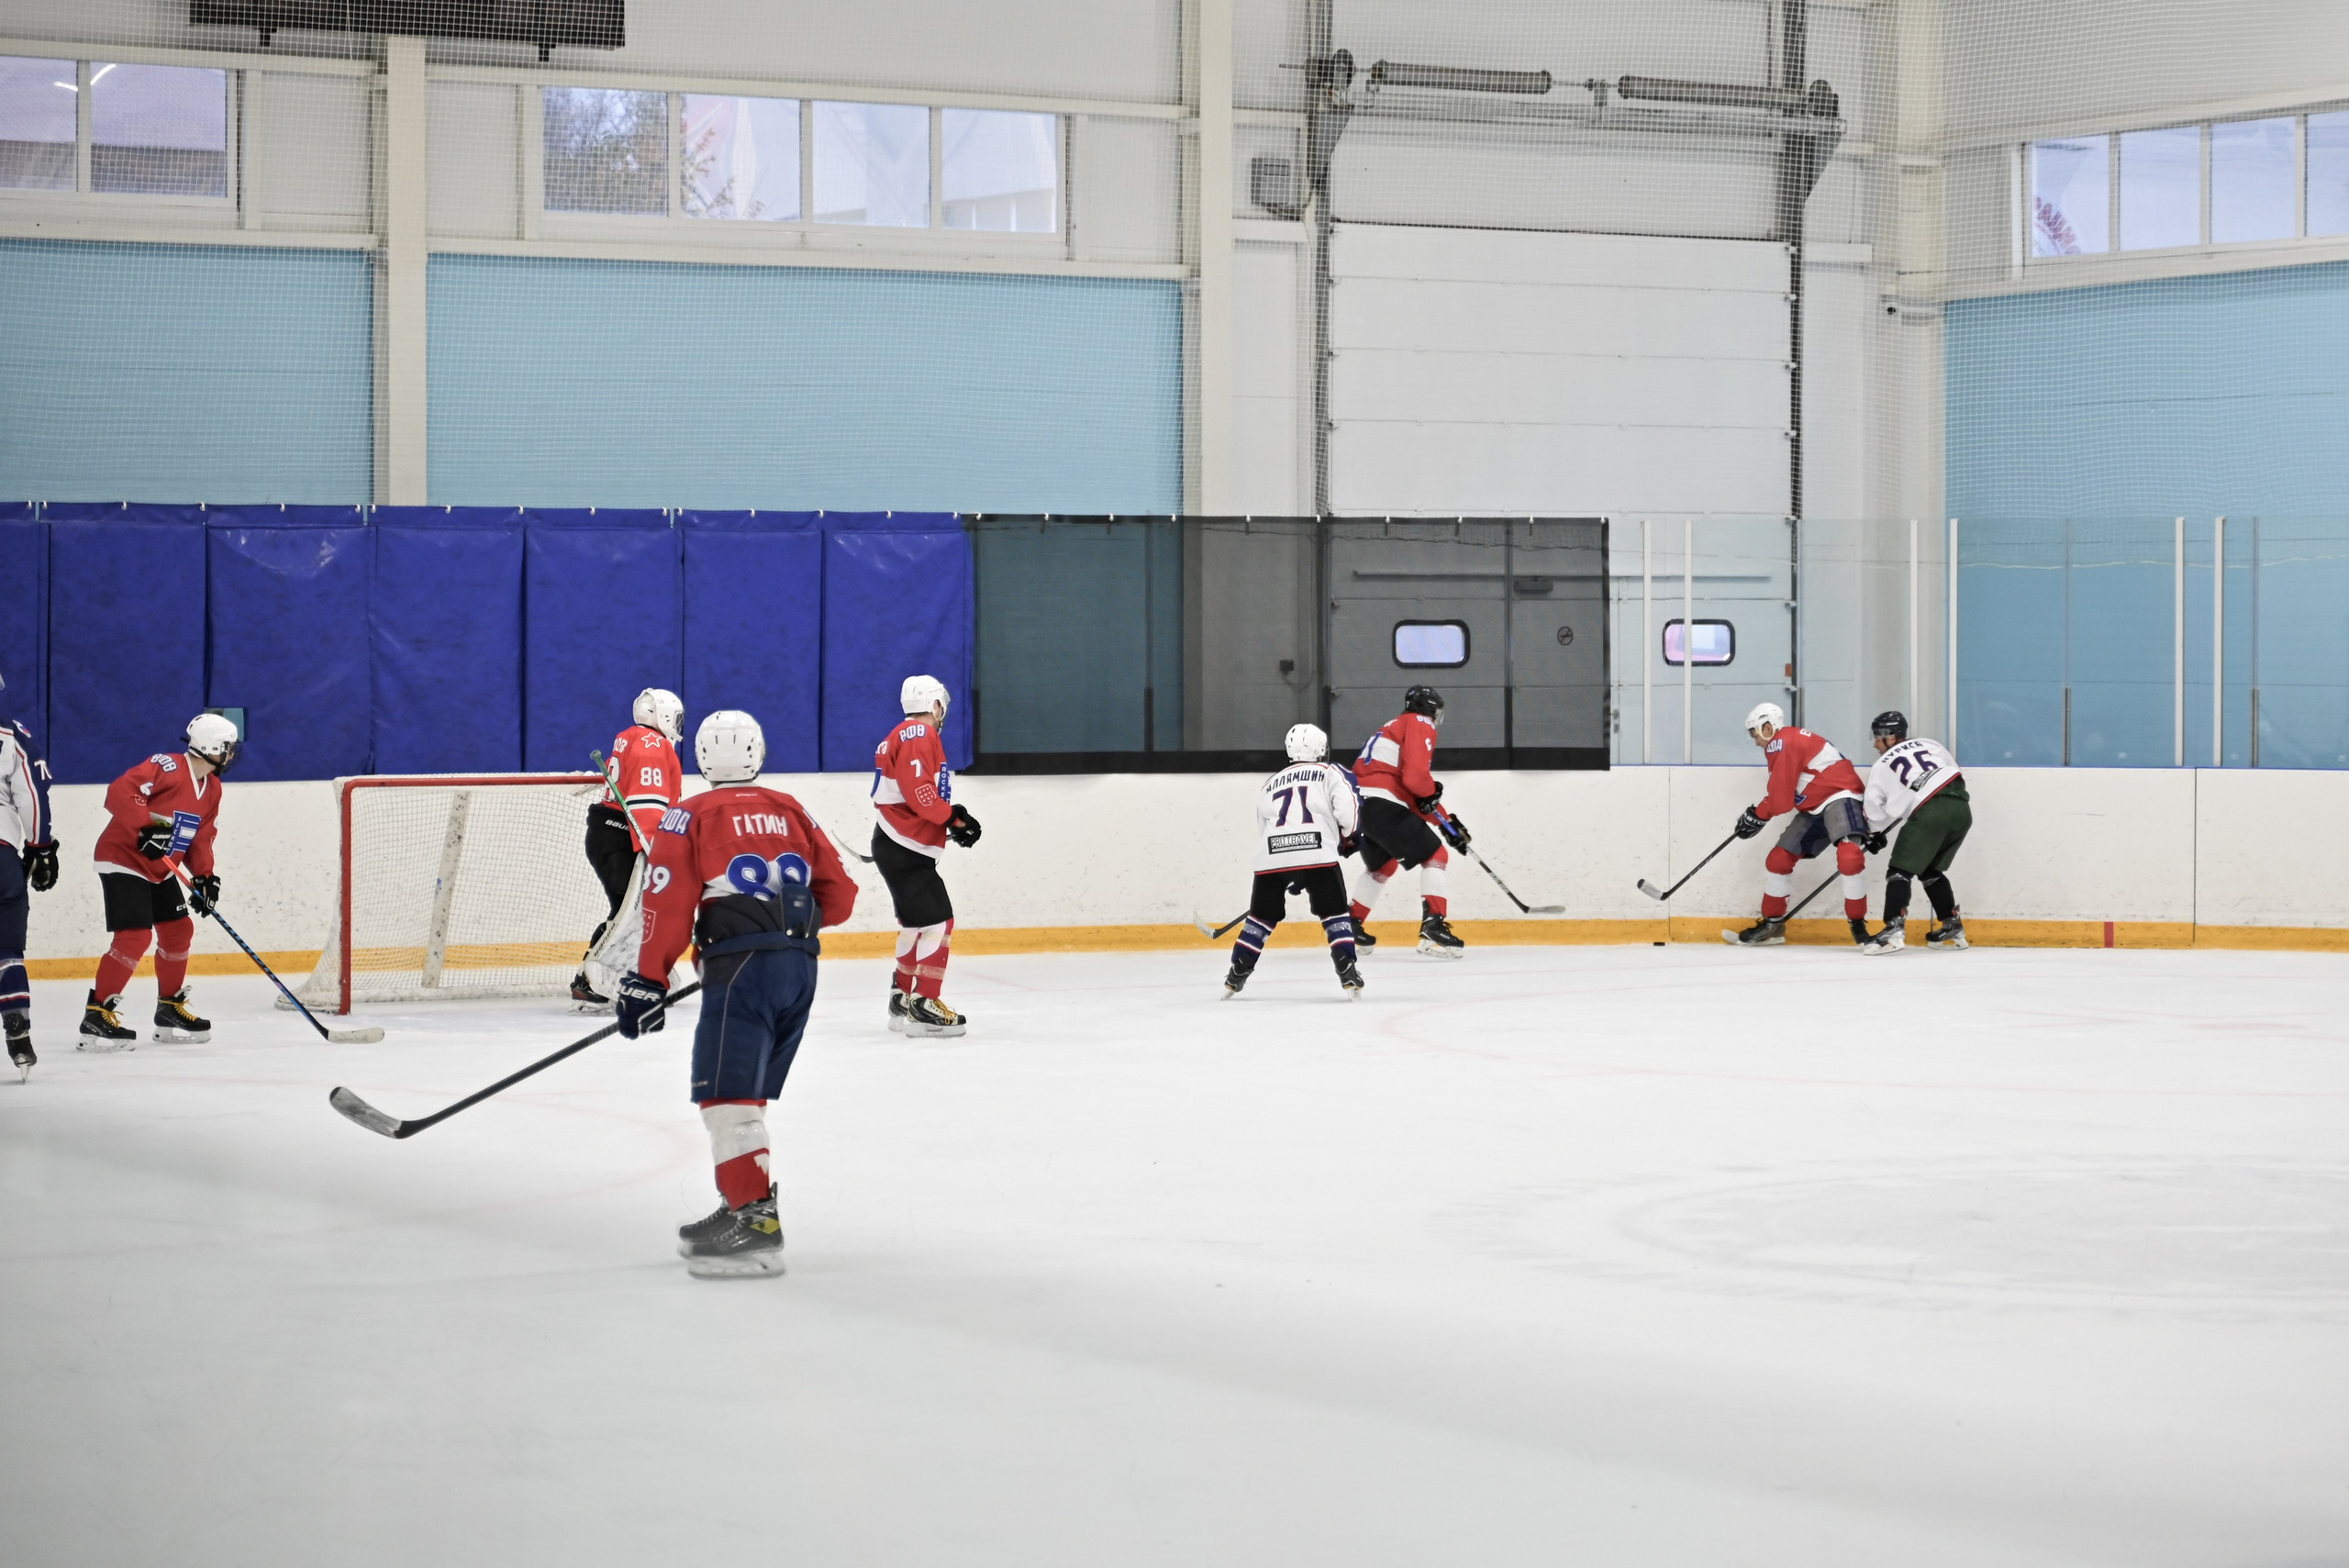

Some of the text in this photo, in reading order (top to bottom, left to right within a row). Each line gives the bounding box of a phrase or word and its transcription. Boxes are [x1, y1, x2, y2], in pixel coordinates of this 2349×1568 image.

[640, 766, 662, 787] 88
[910, 759, 922, 778] 7
[1889, 750, 1940, 787] 26
[940, 766, 948, 803] ROCKE
[1272, 785, 1315, 828] 71
[732, 813, 788, 837] ГАТИН
